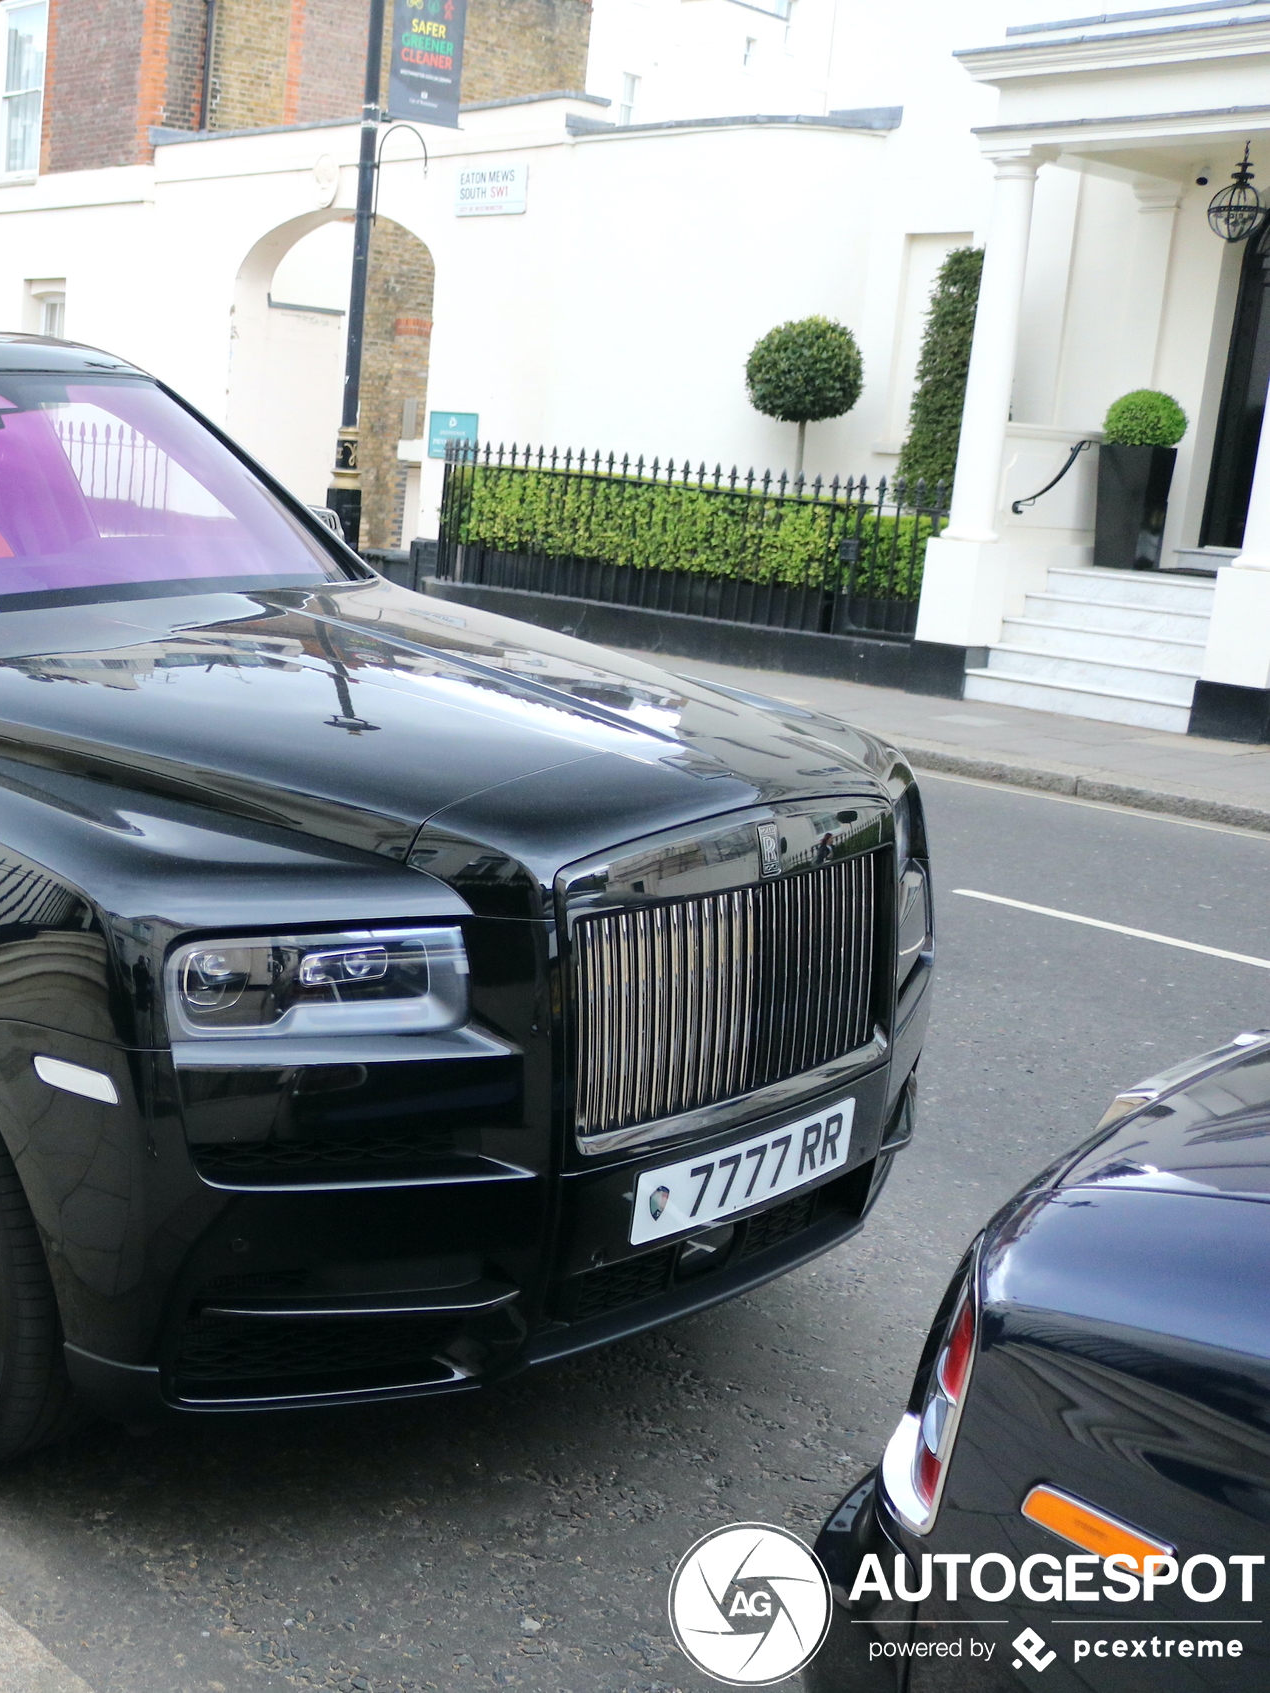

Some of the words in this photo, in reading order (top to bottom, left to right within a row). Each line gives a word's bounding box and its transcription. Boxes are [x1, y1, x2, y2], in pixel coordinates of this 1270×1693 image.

[411, 18, 446, 39] SAFER
[401, 32, 454, 56] GREENER
[400, 48, 453, 70] CLEANER
[460, 171, 487, 185] EATON
[488, 169, 515, 183] MEWS
[459, 187, 487, 200] SOUTH
[490, 186, 508, 199] SW1
[689, 1134, 792, 1218] 7777
[797, 1112, 844, 1176] RR
